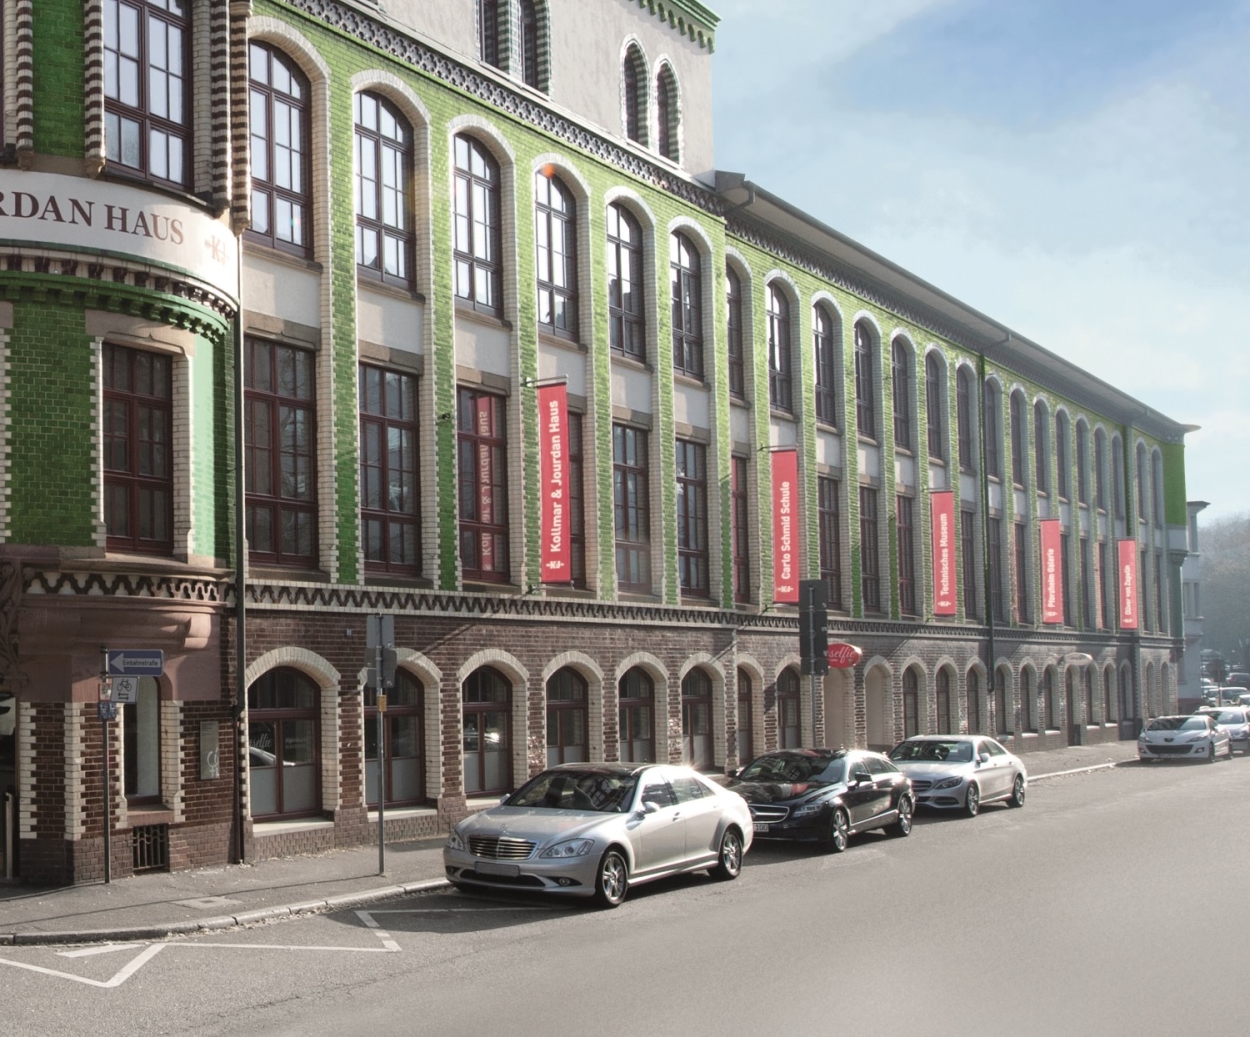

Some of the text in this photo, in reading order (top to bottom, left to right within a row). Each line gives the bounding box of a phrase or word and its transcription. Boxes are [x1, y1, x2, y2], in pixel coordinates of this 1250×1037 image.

[104, 205, 184, 245] HAUS
[548, 401, 563, 552] Kollmar & Jourdan Haus
[780, 481, 791, 580] Carlo Schmid Schule
[939, 513, 949, 596] Technisches Museum
[824, 646, 855, 664] selfie
